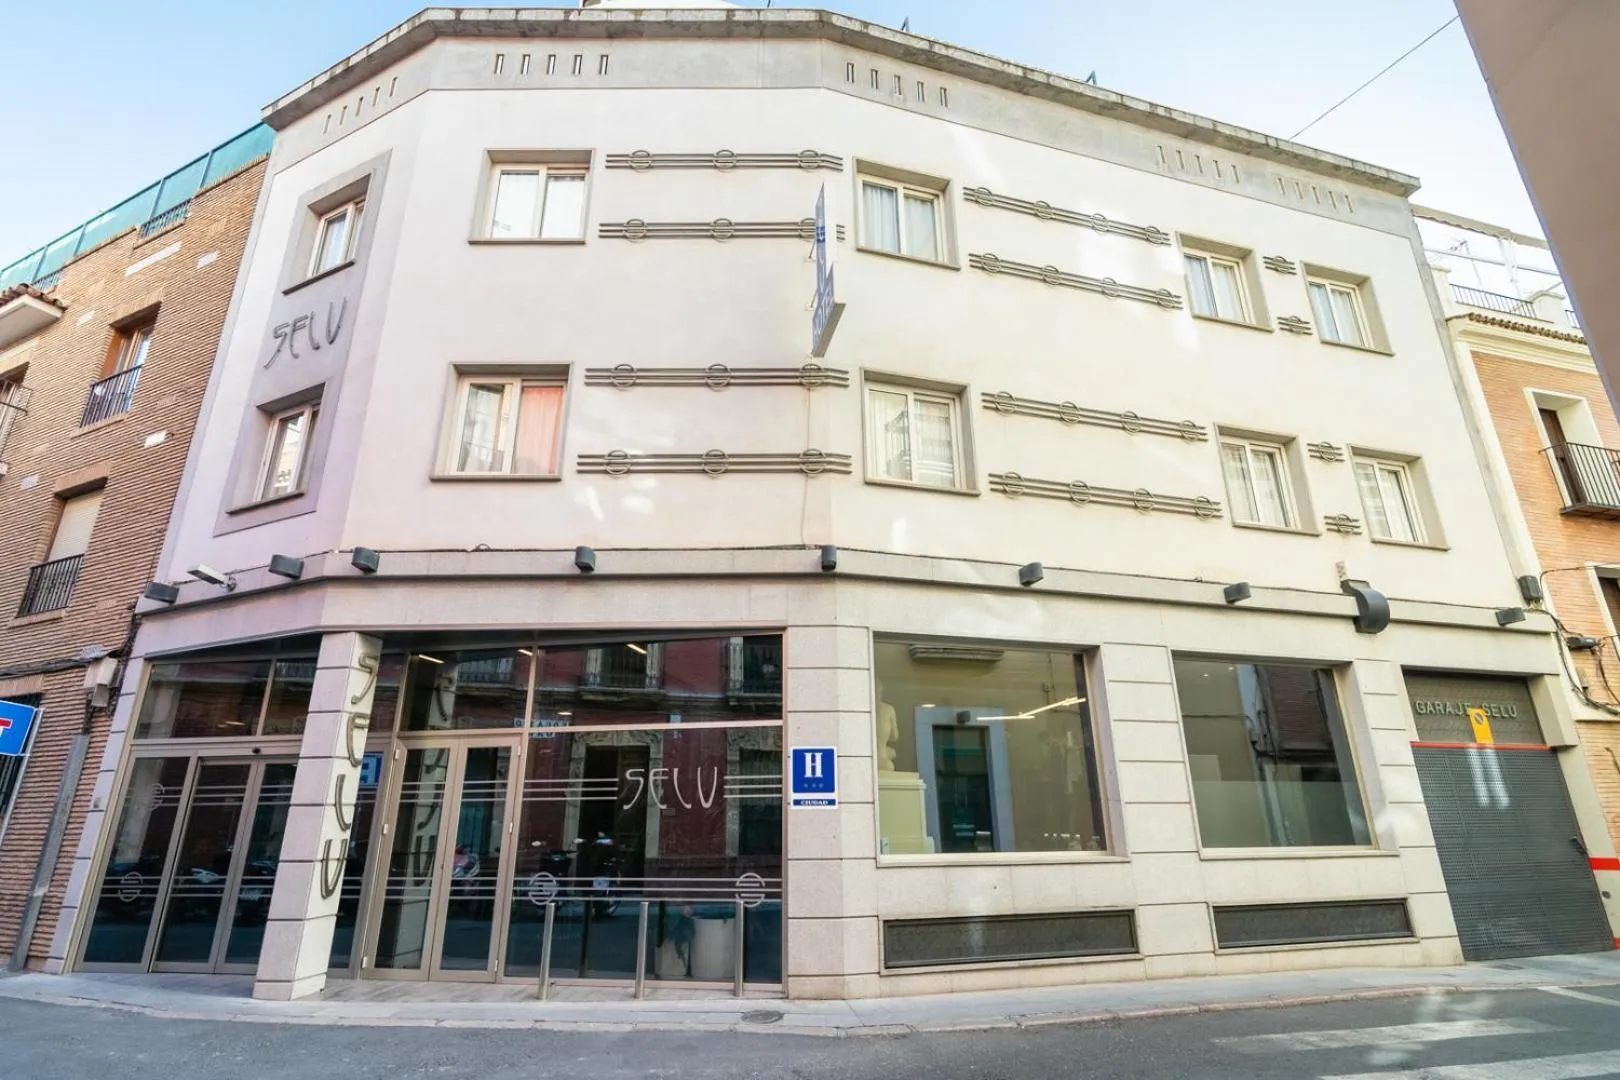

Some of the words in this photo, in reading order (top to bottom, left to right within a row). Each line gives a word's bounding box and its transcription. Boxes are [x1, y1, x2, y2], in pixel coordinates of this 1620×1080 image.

[264, 297, 348, 370] SELU
[1416, 700, 1472, 716] GARAJE
[1481, 701, 1519, 718] SELU
[319, 654, 380, 899] SELU
[803, 752, 823, 778] H
[623, 766, 718, 810] SELU
